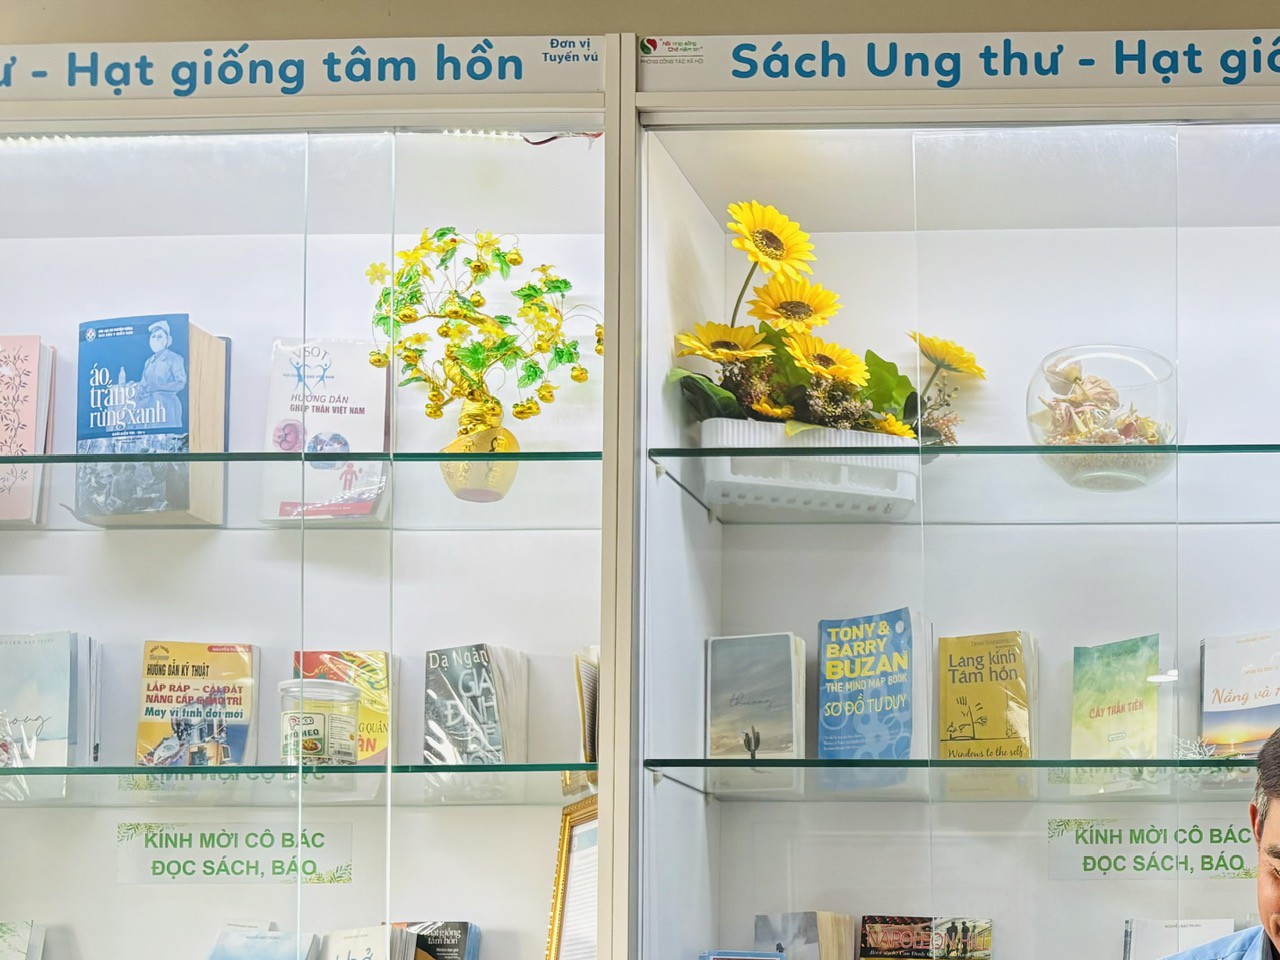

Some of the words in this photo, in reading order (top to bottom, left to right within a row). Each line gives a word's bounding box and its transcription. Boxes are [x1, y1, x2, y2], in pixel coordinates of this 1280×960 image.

[549, 38, 576, 49] Đơn
[582, 38, 591, 51] vị
[68, 52, 154, 96] Hạt
[171, 43, 305, 97] giống
[322, 45, 417, 82] tâm
[436, 38, 524, 81] hồn
[542, 52, 579, 64] Tuyến
[583, 51, 599, 63] vú
[731, 40, 846, 78] Sách
[867, 42, 961, 88] Ung
[979, 38, 1064, 76] thư
[1115, 39, 1203, 84] Hạt
[90, 363, 110, 386] áo
[90, 380, 137, 409] trắng
[89, 408, 127, 430] rừng
[127, 401, 167, 424] xanh
[827, 623, 876, 641] TONY
[878, 621, 890, 636] &
[826, 638, 888, 658] BARRY
[825, 651, 909, 680] BUZAN
[825, 682, 843, 693] THE
[845, 680, 867, 692] MIND
[868, 677, 886, 689] MAP
[885, 694, 907, 711] DUY
[986, 747, 994, 757] to
[995, 746, 1008, 757] the
[144, 829, 193, 849] KÍNH
[199, 828, 239, 849] MỜI
[245, 828, 275, 849] CÔ
[281, 828, 326, 849] BÁC
[1075, 825, 1123, 845] KÍNH
[1129, 824, 1168, 845] MỜI
[1174, 824, 1203, 844] CÔ
[1209, 824, 1252, 844] BÁC
[151, 859, 196, 880] ĐỌC
[202, 855, 265, 878] SÁCH,
[271, 855, 317, 876] BÁO
[1082, 855, 1127, 875] ĐỌC
[1133, 851, 1194, 874] SÁCH,
[1200, 850, 1245, 871] BÁO
[867, 930, 956, 949] NAPOLEON
